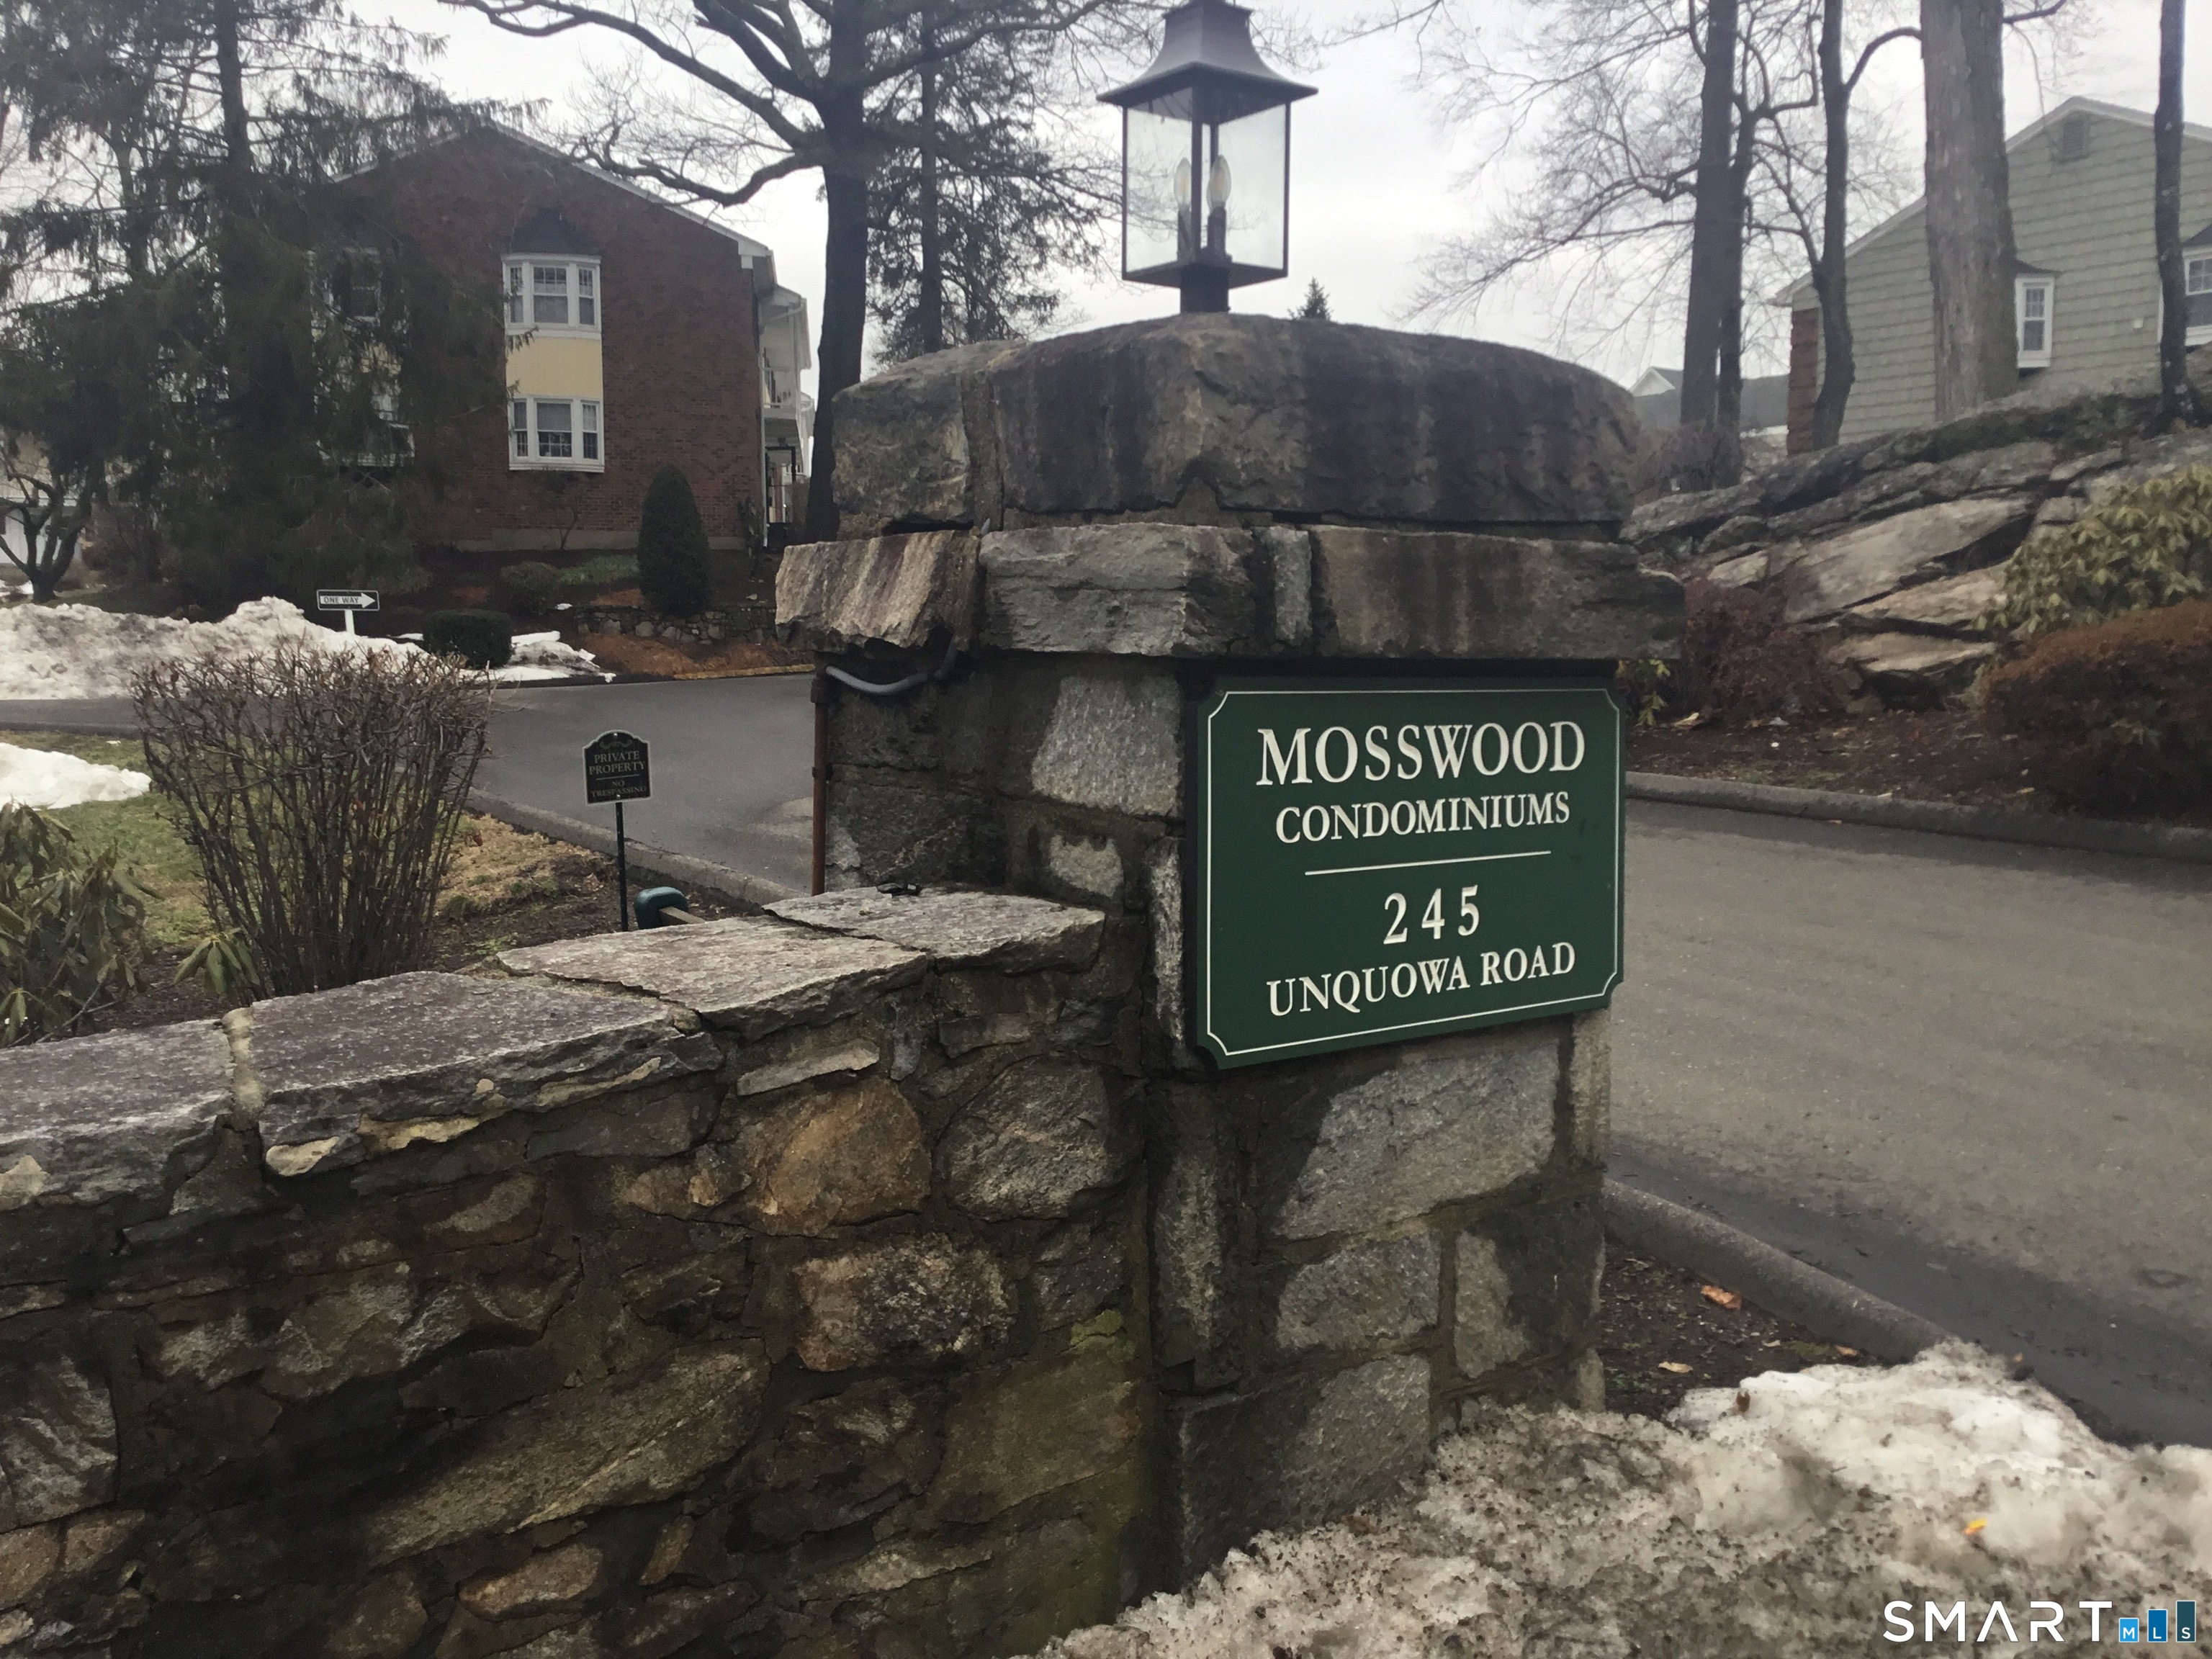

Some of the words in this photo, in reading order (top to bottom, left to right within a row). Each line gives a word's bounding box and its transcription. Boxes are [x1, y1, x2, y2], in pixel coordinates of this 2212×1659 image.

[588, 761, 645, 775] PROPERTY
[594, 750, 640, 763] PRIVATE
[1256, 721, 1585, 786] MOSSWOOD
[590, 786, 647, 797] TRESPASSING
[1275, 791, 1570, 843] CONDOMINIUMS
[1383, 885, 1480, 945] 245
[1267, 956, 1470, 1017] UNQUOWA
[1480, 942, 1575, 986] ROAD
